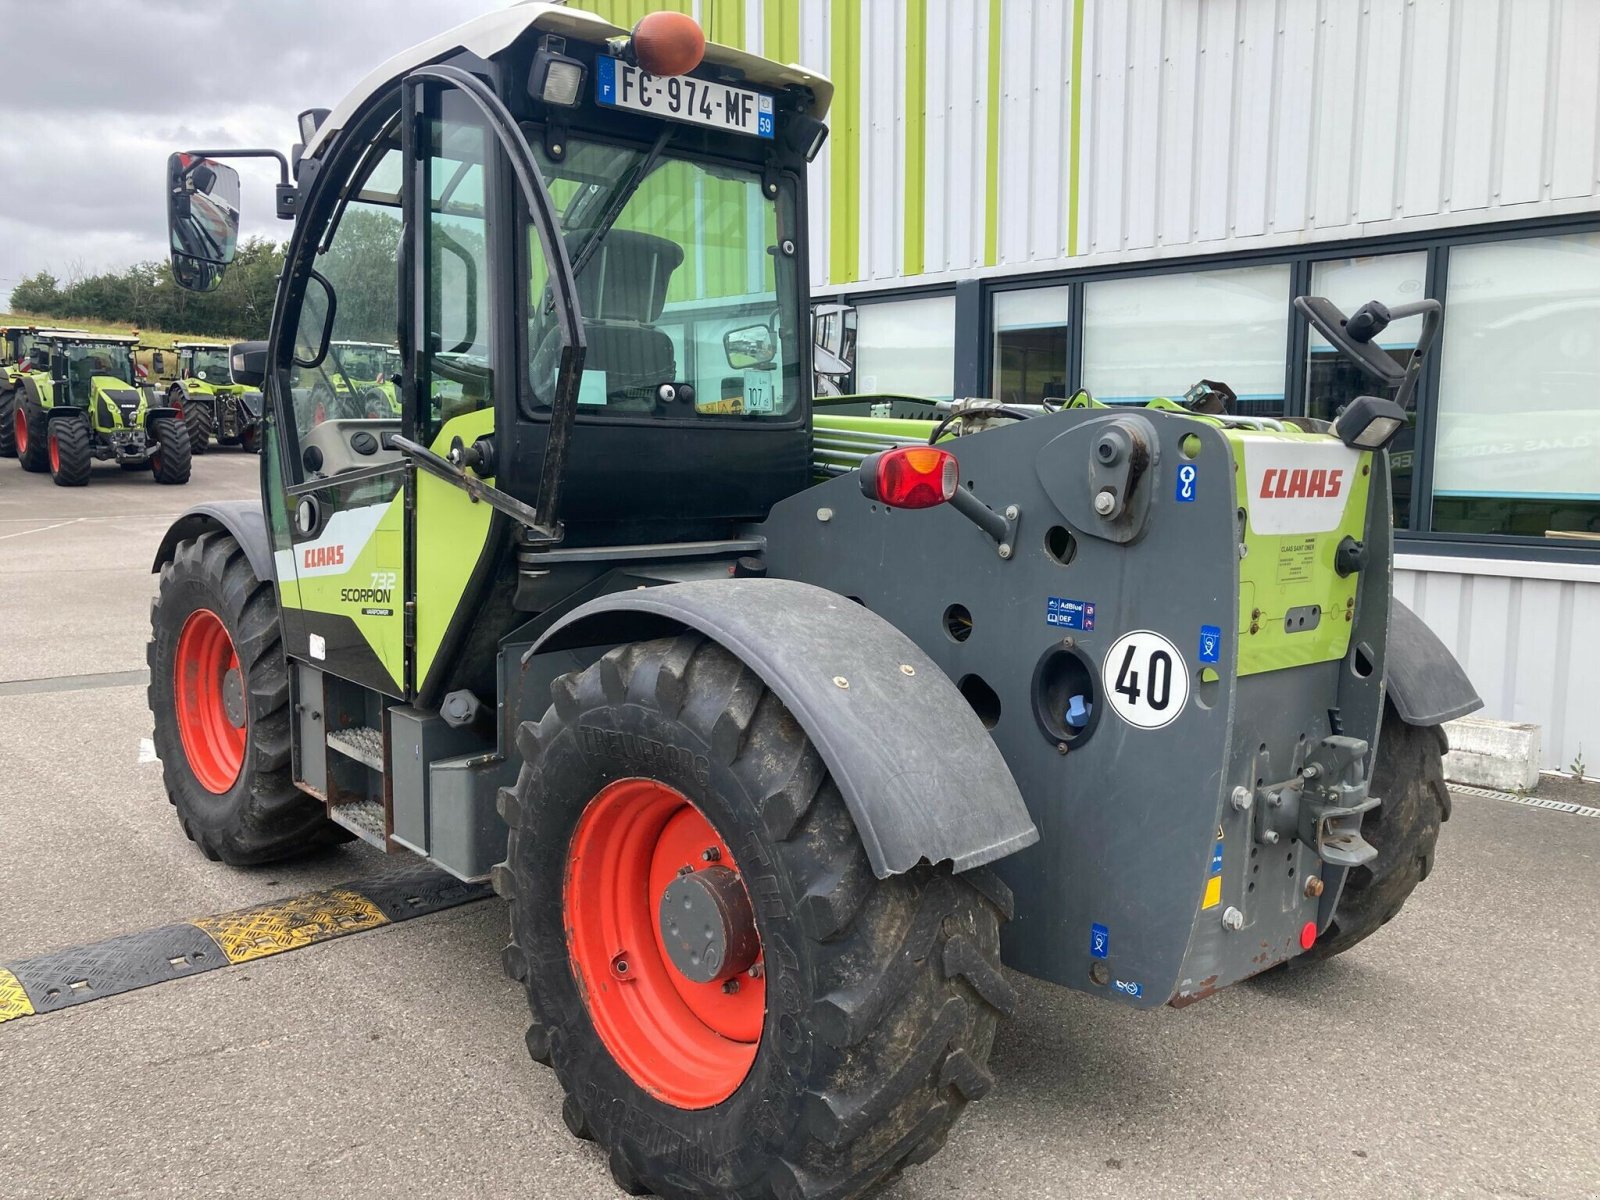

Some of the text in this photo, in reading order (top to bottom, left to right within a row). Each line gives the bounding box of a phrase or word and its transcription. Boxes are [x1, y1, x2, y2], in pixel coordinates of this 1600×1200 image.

[604, 85, 610, 95] F
[622, 66, 753, 127] FC-974-MF
[759, 117, 771, 133] 59
[748, 387, 762, 406] 107
[1259, 468, 1343, 498] CLAAS
[304, 544, 344, 568] CLAAS
[370, 572, 396, 590] 732
[341, 588, 391, 603] SCORPION
[1060, 602, 1082, 611] AdBlue
[1060, 614, 1072, 622] DEF
[1115, 645, 1172, 711] 40
